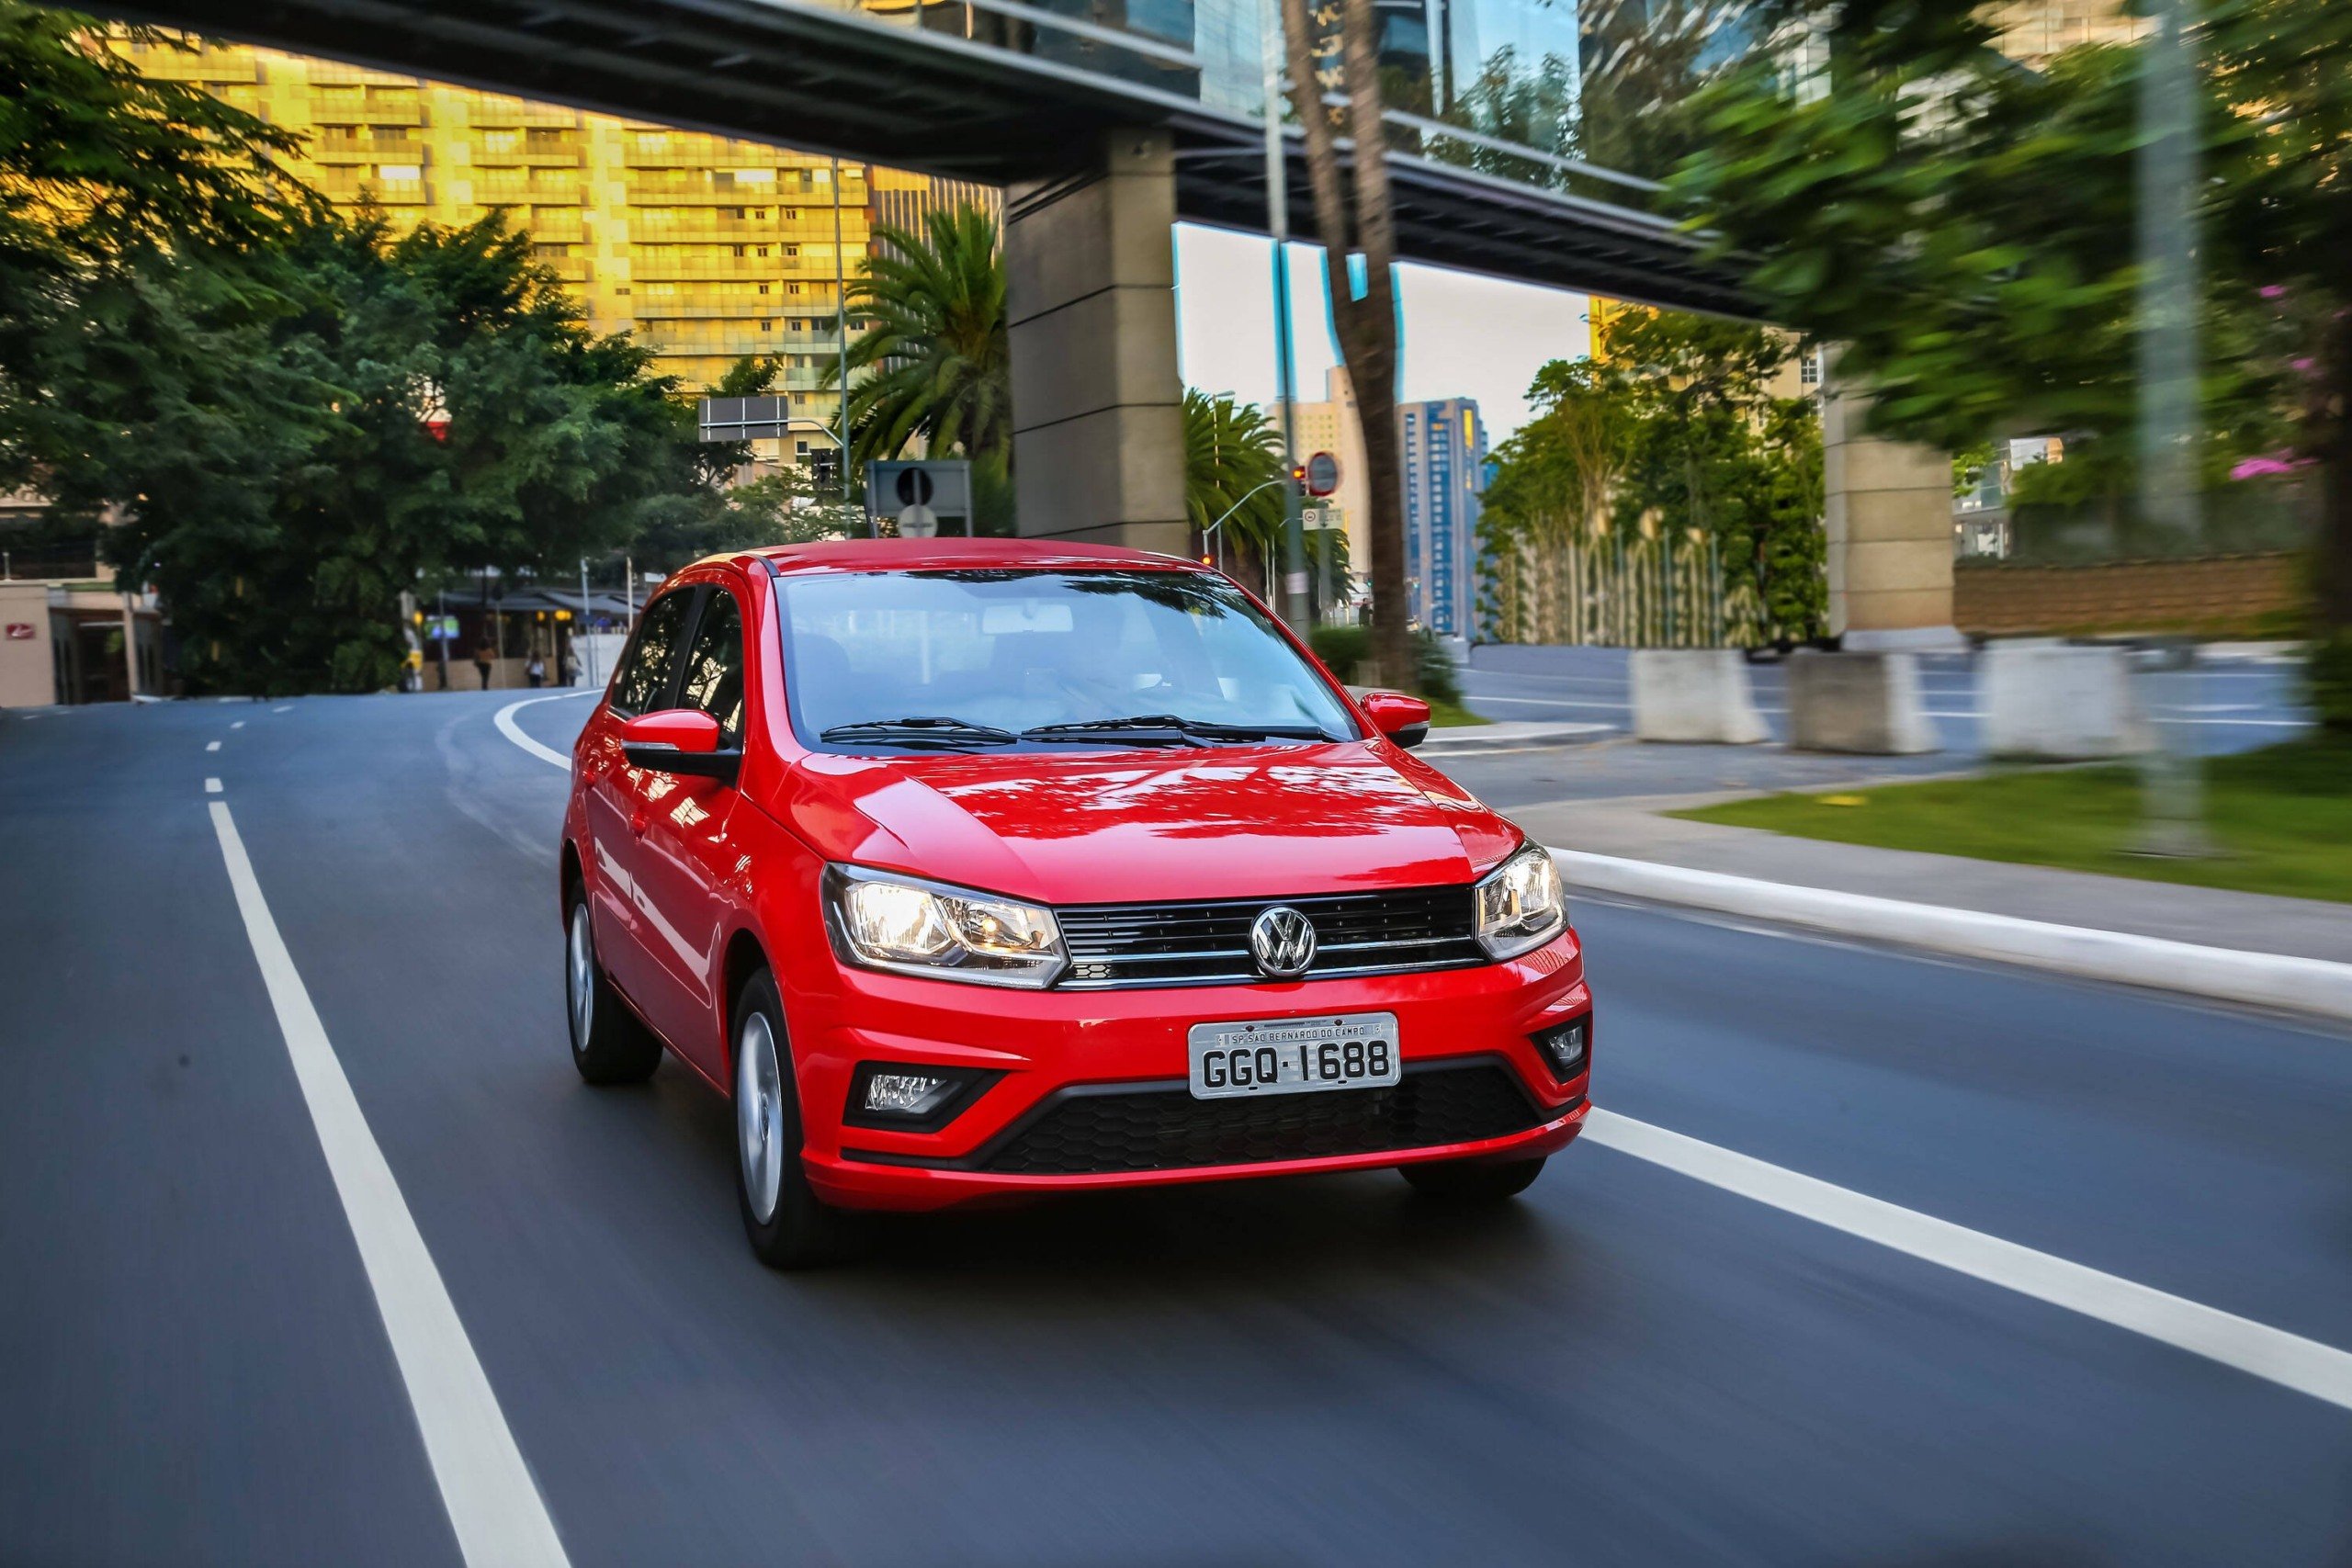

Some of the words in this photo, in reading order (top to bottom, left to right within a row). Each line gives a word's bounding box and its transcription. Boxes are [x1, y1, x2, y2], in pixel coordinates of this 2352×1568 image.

[1232, 1035, 1244, 1044] SP
[1269, 1030, 1317, 1042] BERNARDO
[1321, 1029, 1332, 1038] DO
[1335, 1026, 1364, 1037] CAMPO
